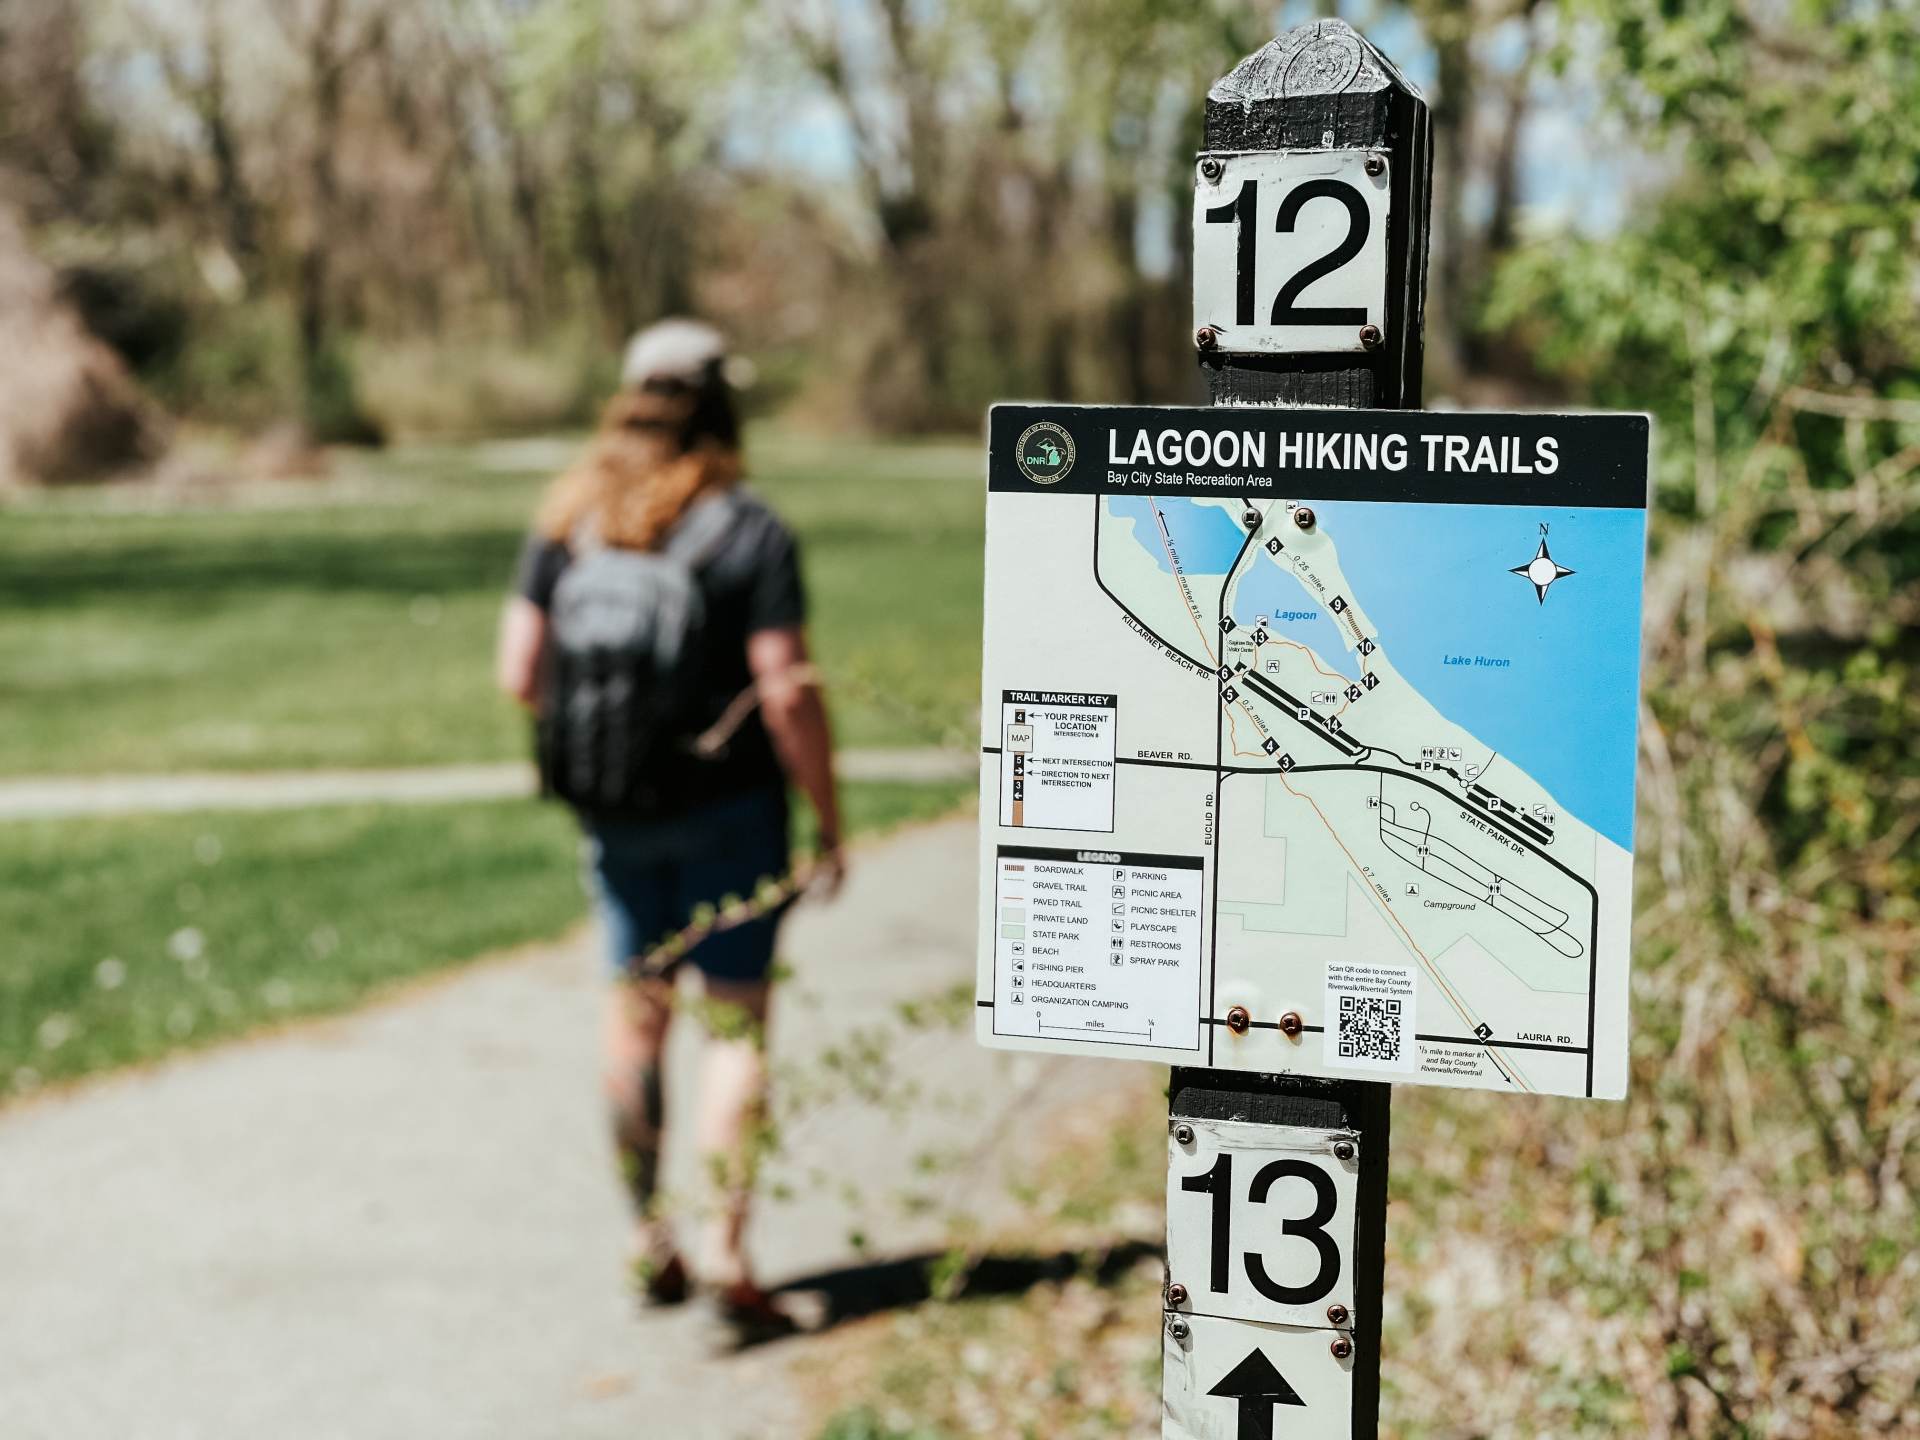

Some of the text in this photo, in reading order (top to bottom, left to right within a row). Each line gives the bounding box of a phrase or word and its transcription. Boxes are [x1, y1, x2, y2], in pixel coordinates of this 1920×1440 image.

[1206, 179, 1370, 325] 12
[1108, 428, 1559, 475] LAGOON HIKING TRAILS
[1026, 456, 1046, 465] DNR
[1107, 471, 1273, 487] Bay City State Recreation Area
[1538, 523, 1550, 535] N
[1271, 540, 1278, 551] 8
[1293, 555, 1326, 592] 0.25 miles
[1169, 548, 1180, 565] mile
[1176, 566, 1183, 575] to
[1180, 576, 1195, 603] marker
[1191, 604, 1203, 620] #15
[1335, 599, 1342, 610] 9
[1275, 609, 1317, 622] Lagoon
[1223, 619, 1230, 631] 7
[1253, 631, 1265, 643] 13
[1121, 614, 1211, 681] KILLARNEY BEACH RD.
[1359, 641, 1371, 653] 10
[1443, 654, 1510, 668] Lake Huron
[1221, 668, 1228, 680] 6
[1364, 676, 1375, 687] 11
[1010, 692, 1109, 706] TRAIL MARKER KEY
[1226, 689, 1233, 700] 5
[1347, 688, 1358, 699] 12
[1044, 712, 1109, 723] YOUR PRESENT
[1242, 699, 1269, 733] 0.2 miles
[1300, 710, 1308, 719] P
[1055, 722, 1097, 731] LOCATION
[1327, 720, 1338, 731] 14
[1011, 734, 1030, 743] MAP
[1266, 741, 1274, 752] 4
[1016, 756, 1022, 765] 5
[1137, 750, 1193, 761] BEAVER RD.
[1042, 757, 1113, 768] NEXT INTERSECTION
[1282, 757, 1289, 768] 3
[1423, 761, 1432, 770] P
[1041, 771, 1079, 779] DIRECTION
[1015, 781, 1021, 789] 3
[1041, 779, 1092, 788] INTERSECTION
[1490, 799, 1499, 809] P
[1204, 791, 1214, 846] EUCLID RD.
[1459, 811, 1526, 857] STATE PARK DR.
[1077, 851, 1121, 863] LEGEND
[1034, 865, 1085, 875] BOARDWALK
[1116, 870, 1123, 879] P
[1131, 872, 1167, 881] PARKING
[1032, 881, 1087, 892] GRAVEL TRAIL
[1362, 866, 1392, 903] 0.7 miles
[1131, 889, 1182, 899] PICNIC AREA
[1033, 898, 1083, 908] PAVED TRAIL
[1423, 899, 1476, 911] Campground
[1131, 906, 1197, 917] PICNIC SHELTER
[1033, 914, 1089, 925] PRIVATE LAND
[1130, 923, 1177, 933] PLAYSCAPE
[1032, 930, 1080, 940] STATE PARK
[1032, 946, 1059, 955] BEACH
[1130, 940, 1182, 951] RESTROOMS
[1129, 957, 1180, 967] SPRAY PARK
[1031, 963, 1084, 973] FISHING PIER
[1031, 980, 1097, 991] HEADQUARTERS
[1375, 977, 1387, 985] Bay
[1387, 978, 1412, 987] County
[1328, 982, 1413, 996] Riverwalk/Rivertrail System
[1031, 995, 1129, 1010] ORGANIZATION CAMPING
[1036, 1010, 1041, 1018] 0
[1479, 1026, 1487, 1038] 2
[1516, 1032, 1573, 1045] LAURIA RD.
[1440, 1058, 1453, 1066] Bay
[1454, 1059, 1478, 1068] County
[1420, 1064, 1483, 1076] Riverwalk/Rivertrail
[1181, 1152, 1341, 1305] 13
